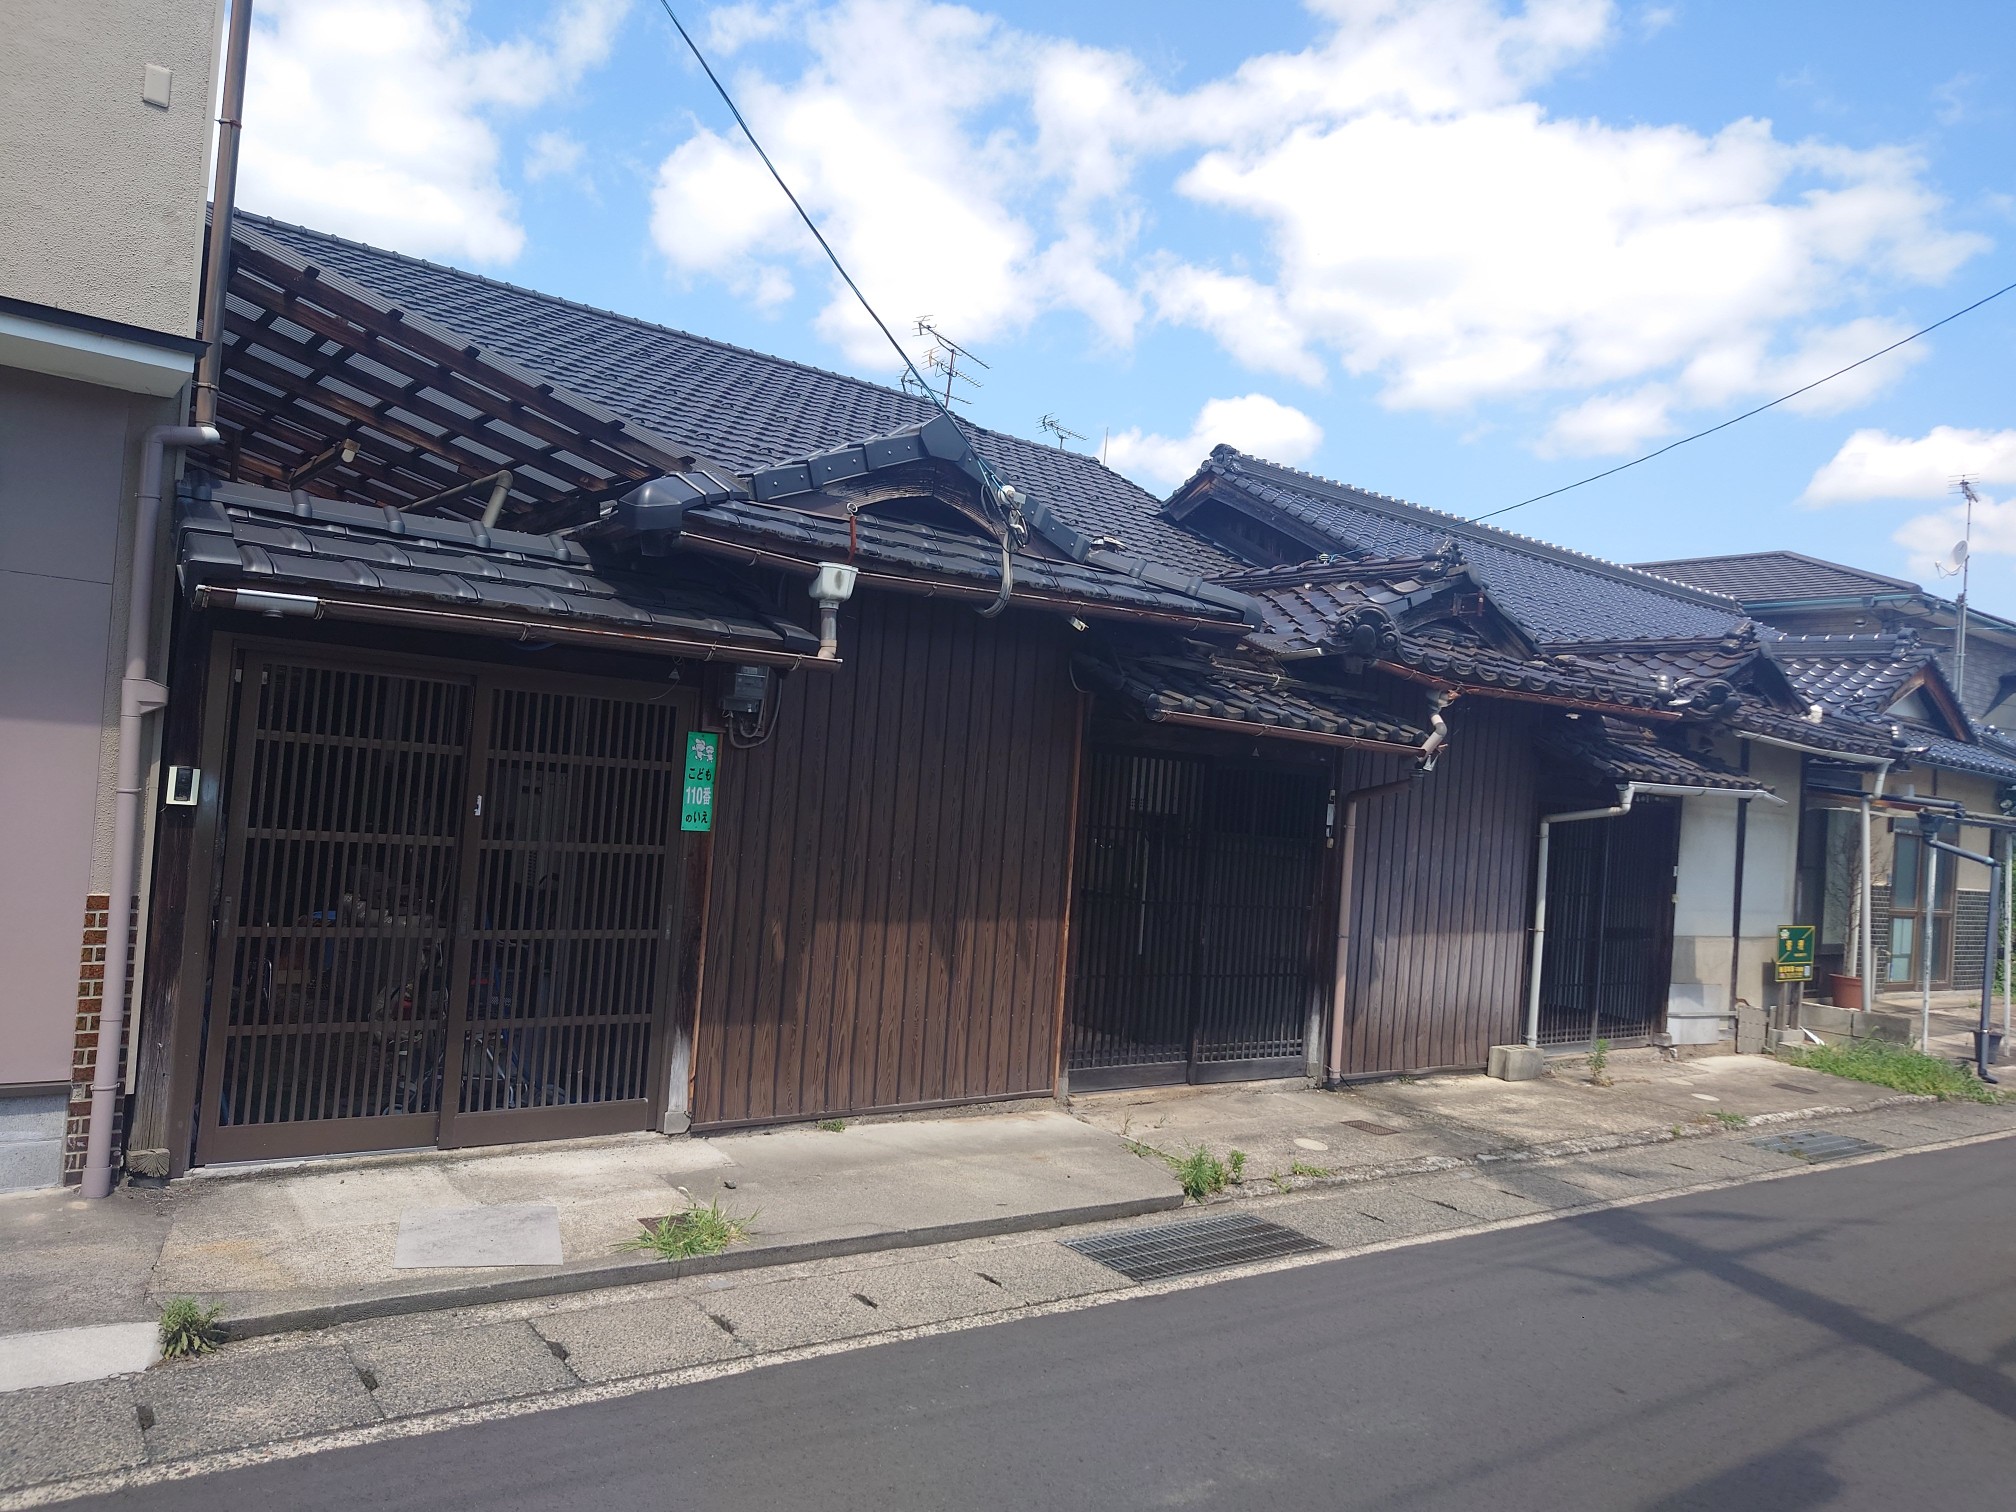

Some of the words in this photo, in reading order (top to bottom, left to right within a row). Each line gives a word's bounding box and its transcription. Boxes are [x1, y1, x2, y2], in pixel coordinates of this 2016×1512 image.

[688, 767, 712, 780] こども
[686, 786, 711, 805] 110番
[685, 811, 708, 824] のいえ
